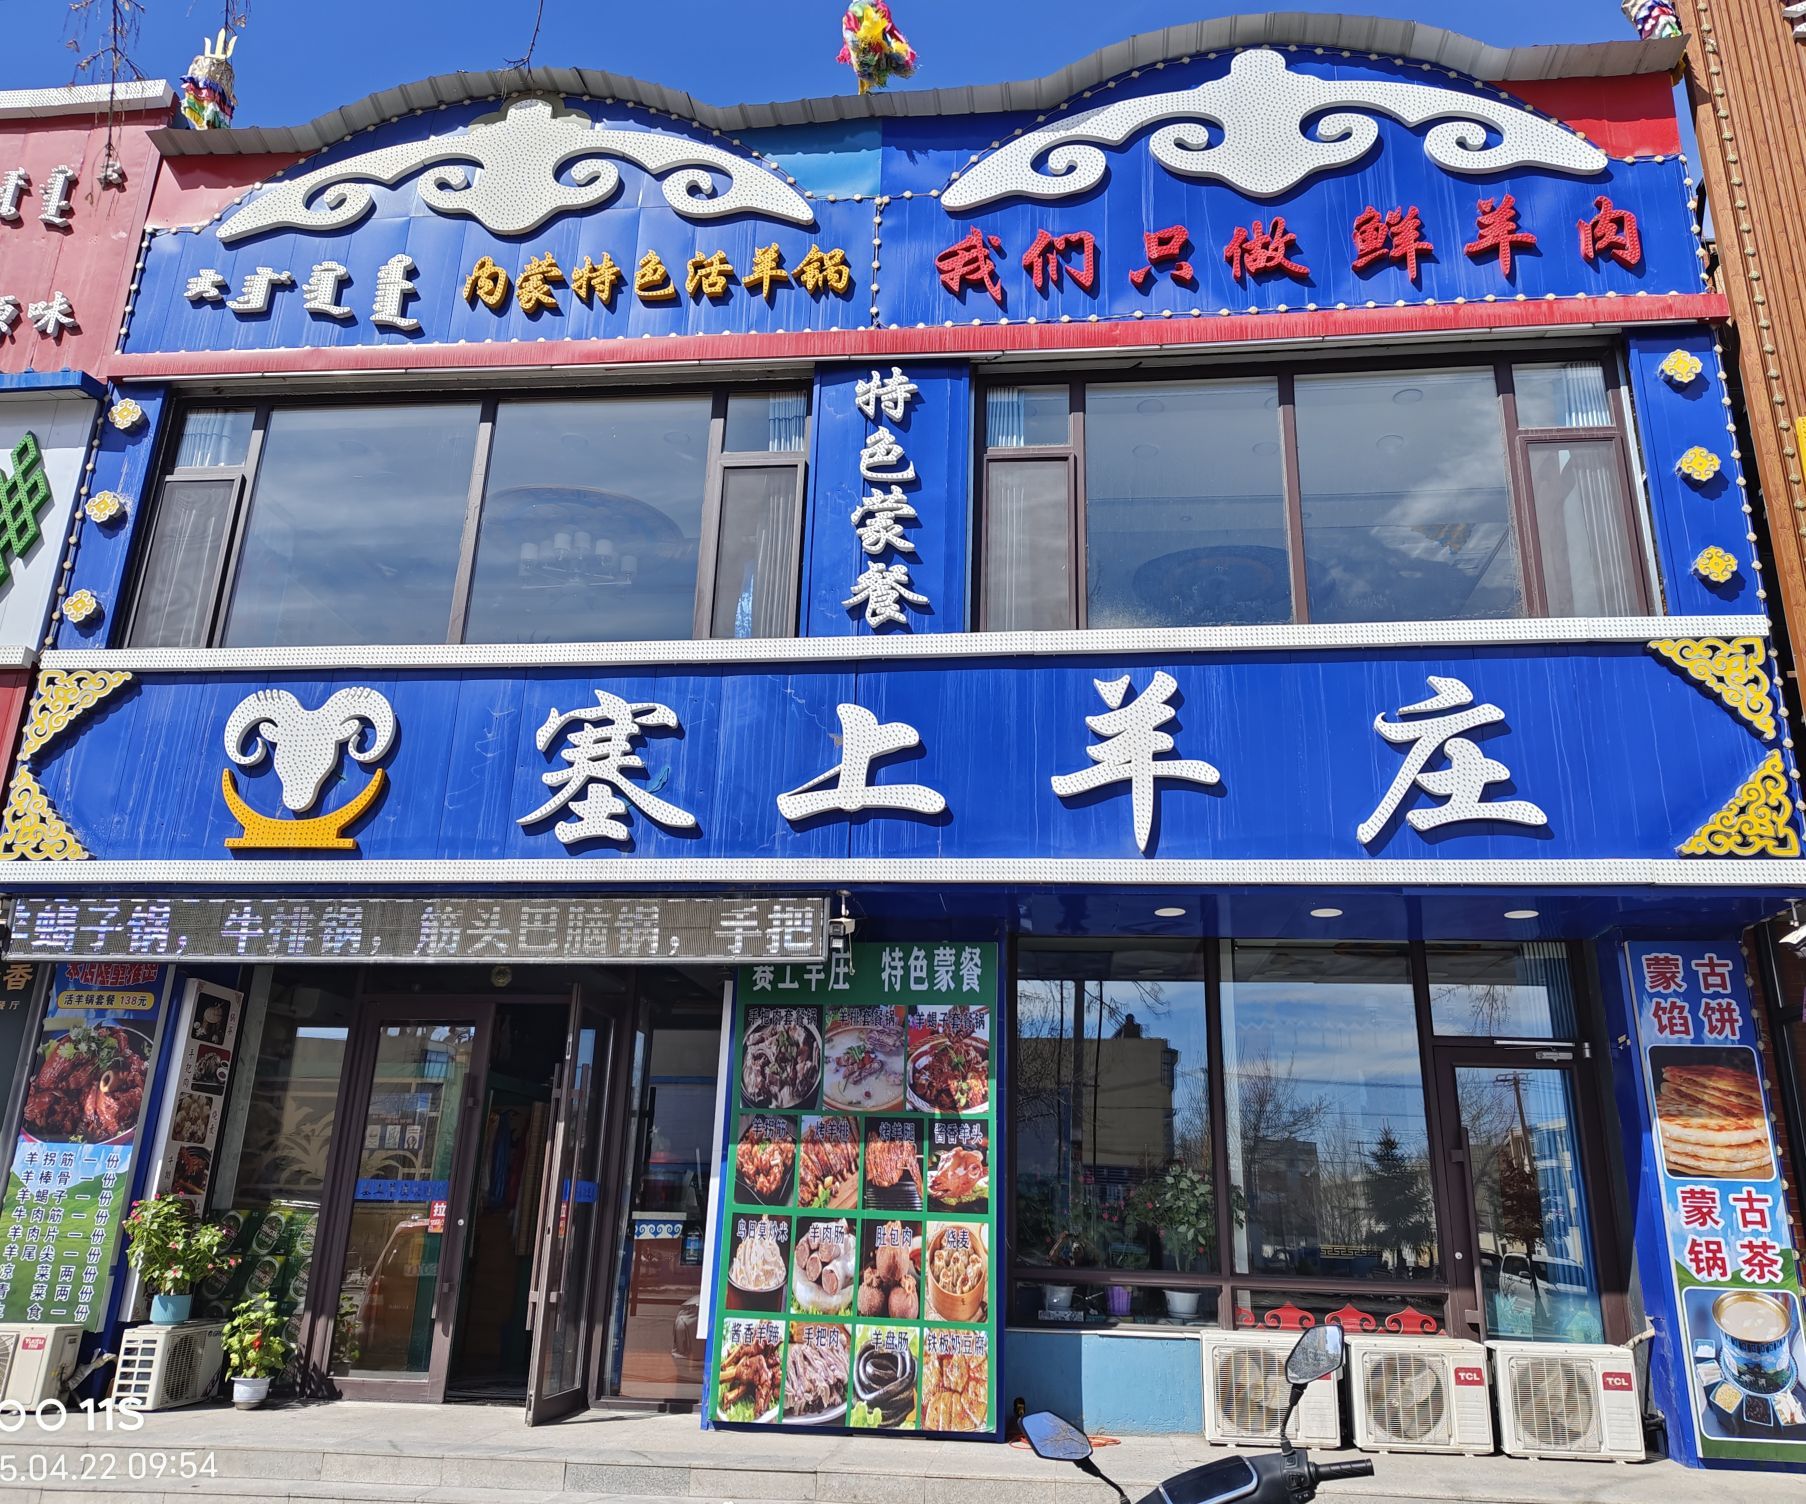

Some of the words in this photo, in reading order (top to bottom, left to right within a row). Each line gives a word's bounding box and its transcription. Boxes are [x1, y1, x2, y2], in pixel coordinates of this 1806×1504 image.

[935, 194, 1644, 301] 我们只做鲜羊肉
[463, 242, 851, 313] 内蒙特色活羊锅
[841, 366, 930, 628] 特色蒙餐
[517, 668, 1548, 854] 塞上羊庄
[881, 946, 982, 993] 特色蒙餐
[1644, 955, 1732, 992] 蒙古
[64, 994, 115, 1006] 活羊锅套餐
[120, 995, 148, 1007] 138元
[747, 1008, 818, 1026] 手把肉套餐锅
[839, 1008, 896, 1027] 羊排套餐锅
[915, 1011, 986, 1031] 羊蝎子套餐锅
[1653, 1000, 1739, 1037] 馅饼
[753, 1118, 788, 1138] 羊拐筋
[815, 1120, 850, 1142] 烤羊排
[879, 1122, 916, 1144] 烤羊腿
[934, 1122, 983, 1145] 酱香羊头
[1679, 1187, 1771, 1230] 蒙古
[809, 1225, 845, 1245] 羊肉肠
[875, 1226, 913, 1248] 肚包肉
[946, 1228, 970, 1250] 烧麦
[1687, 1237, 1781, 1282] 锅茶
[731, 1322, 780, 1343] 酱香羊蹄
[804, 1327, 839, 1347] 手把肉
[872, 1331, 909, 1351] 羊盘肠
[927, 1334, 986, 1356] 铁板奶豆腐
[1457, 1371, 1481, 1382] TCL
[1606, 1376, 1630, 1387] TCL
